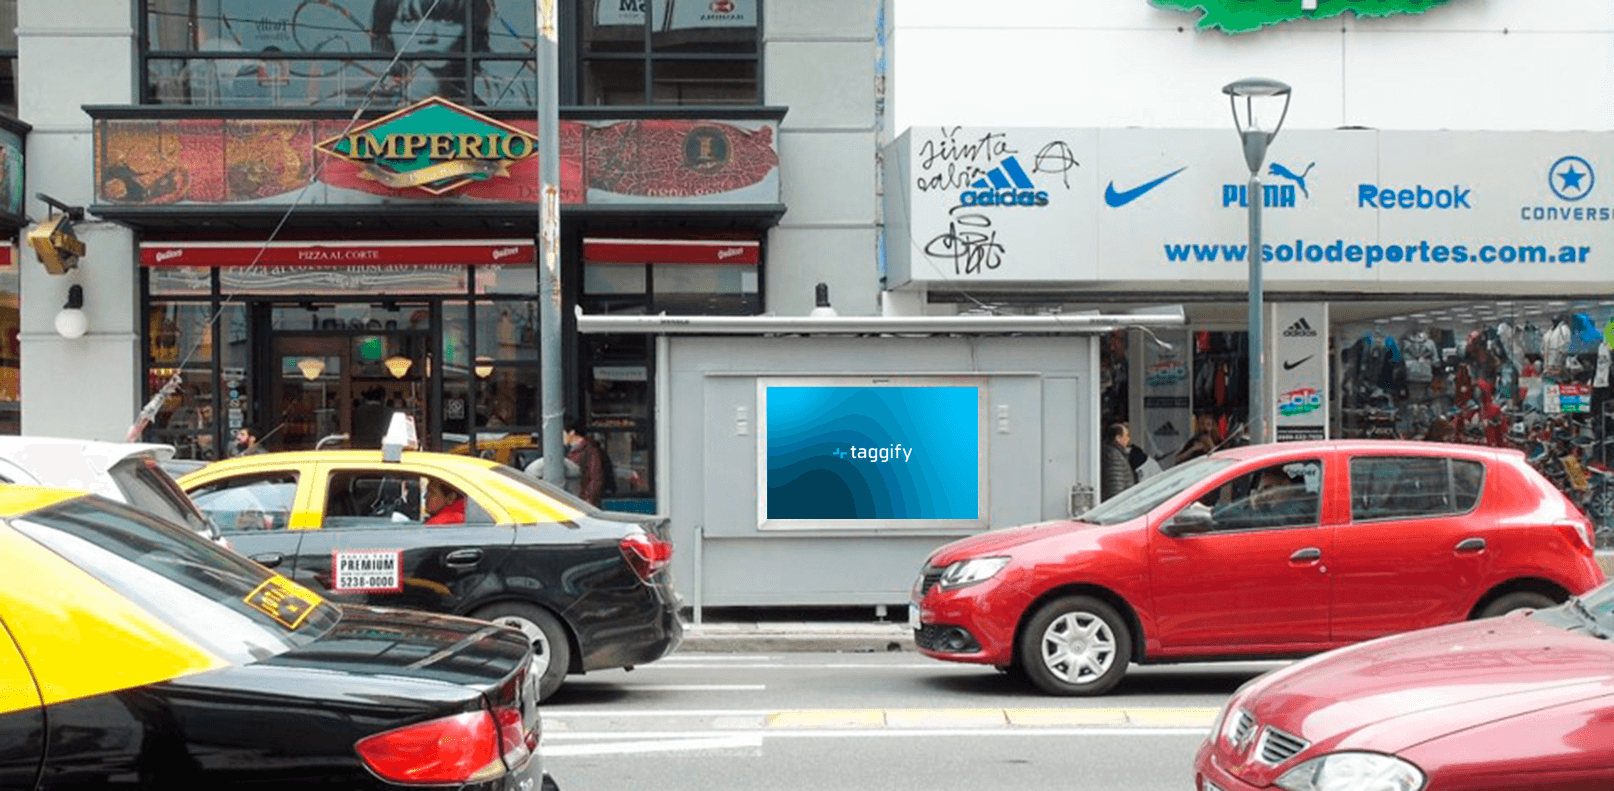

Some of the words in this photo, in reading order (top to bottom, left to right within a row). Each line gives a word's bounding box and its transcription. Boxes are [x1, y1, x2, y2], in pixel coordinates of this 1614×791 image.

[350, 133, 533, 159] IMPERIO
[960, 187, 1049, 207] adidas
[1358, 184, 1472, 209] Reebok
[1521, 207, 1614, 221] CONVERS
[299, 251, 328, 260] PIZZA
[345, 251, 378, 260] CORTE
[1164, 240, 1591, 268] wwwsolodeportes.com.ar
[850, 444, 912, 462] taggify
[340, 559, 394, 571] PREMIUM
[340, 576, 394, 587] 5238-0000
